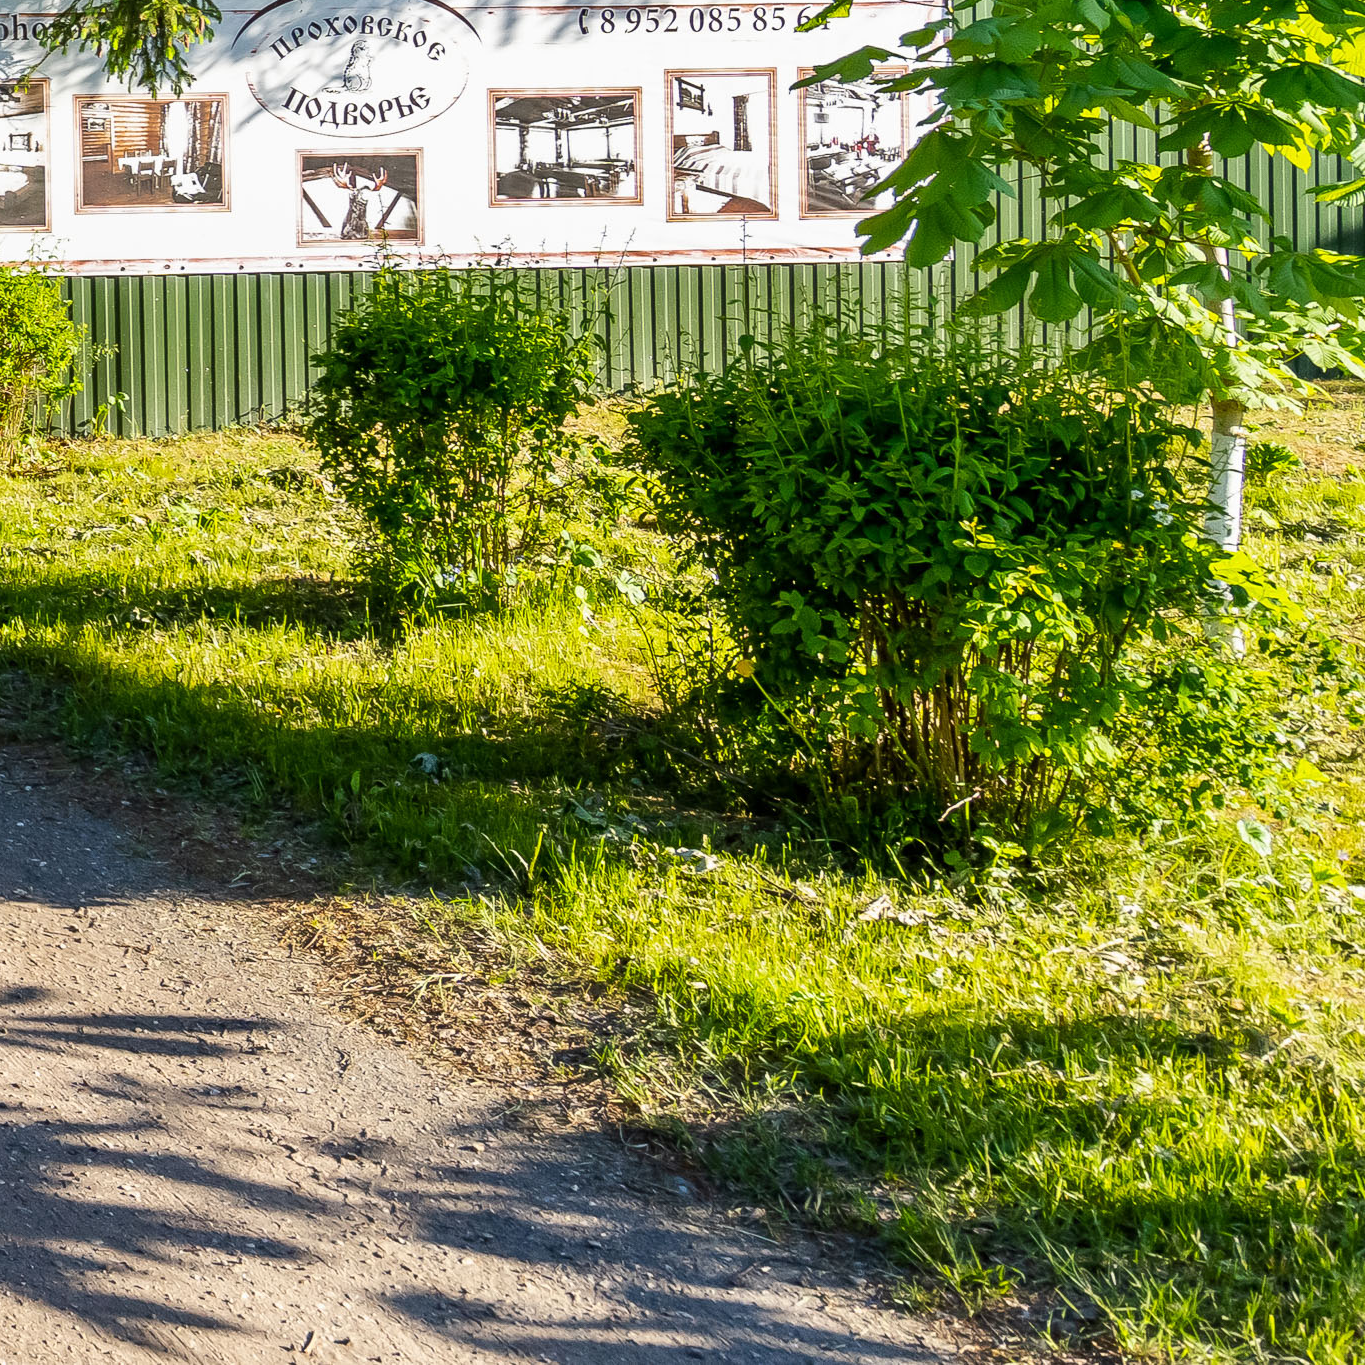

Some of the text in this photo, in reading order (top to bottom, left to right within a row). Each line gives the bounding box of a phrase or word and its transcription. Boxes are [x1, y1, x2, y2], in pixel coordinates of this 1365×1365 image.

[268, 14, 446, 62] ПРОХОВСКОЕ
[600, 8, 616, 34] 8
[624, 8, 680, 34] 952
[689, 7, 742, 33] 085
[752, 6, 787, 32] 85
[281, 86, 431, 129] ПОДВОРЬЕ
